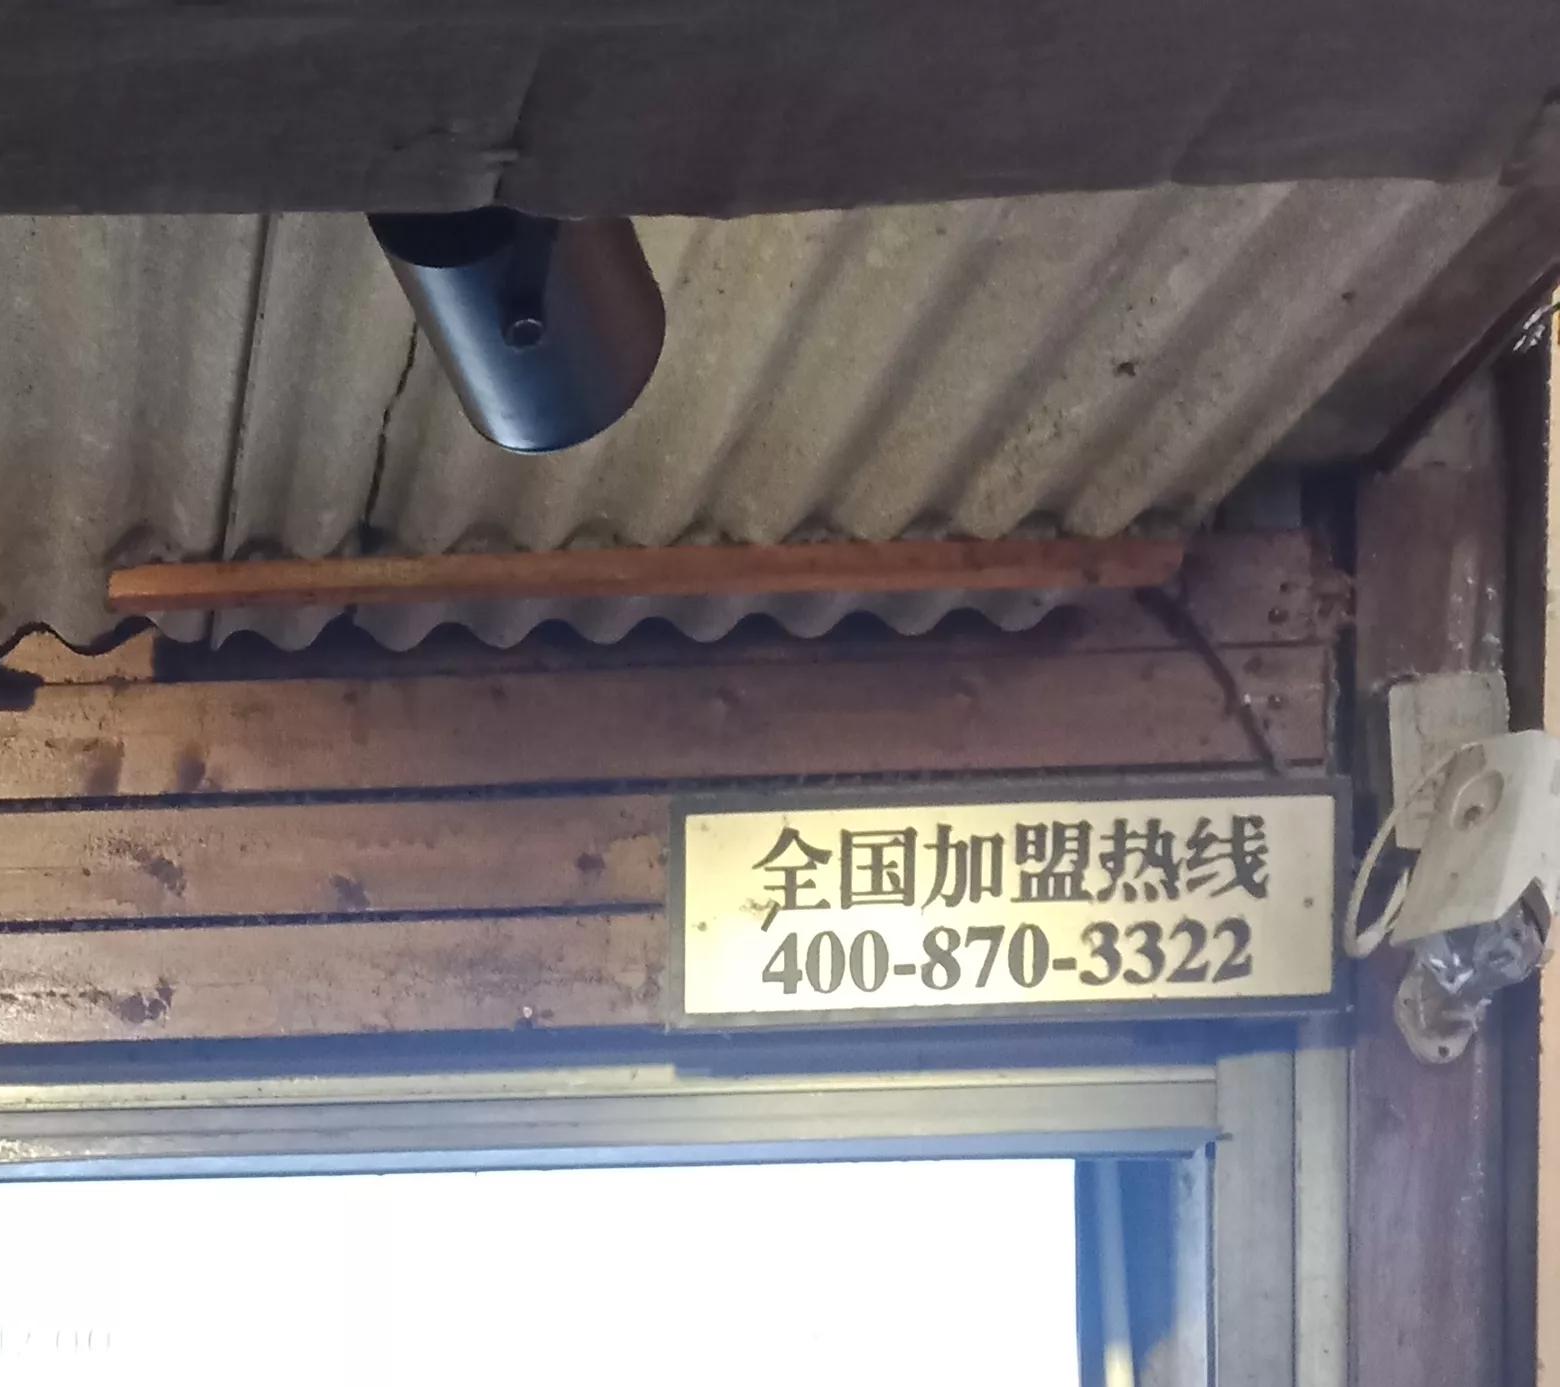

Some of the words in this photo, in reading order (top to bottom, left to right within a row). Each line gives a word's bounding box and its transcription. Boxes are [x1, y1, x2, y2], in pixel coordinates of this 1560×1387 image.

[752, 814, 1271, 912] 全国加盟热线
[761, 917, 1253, 994] 400-870-3322
